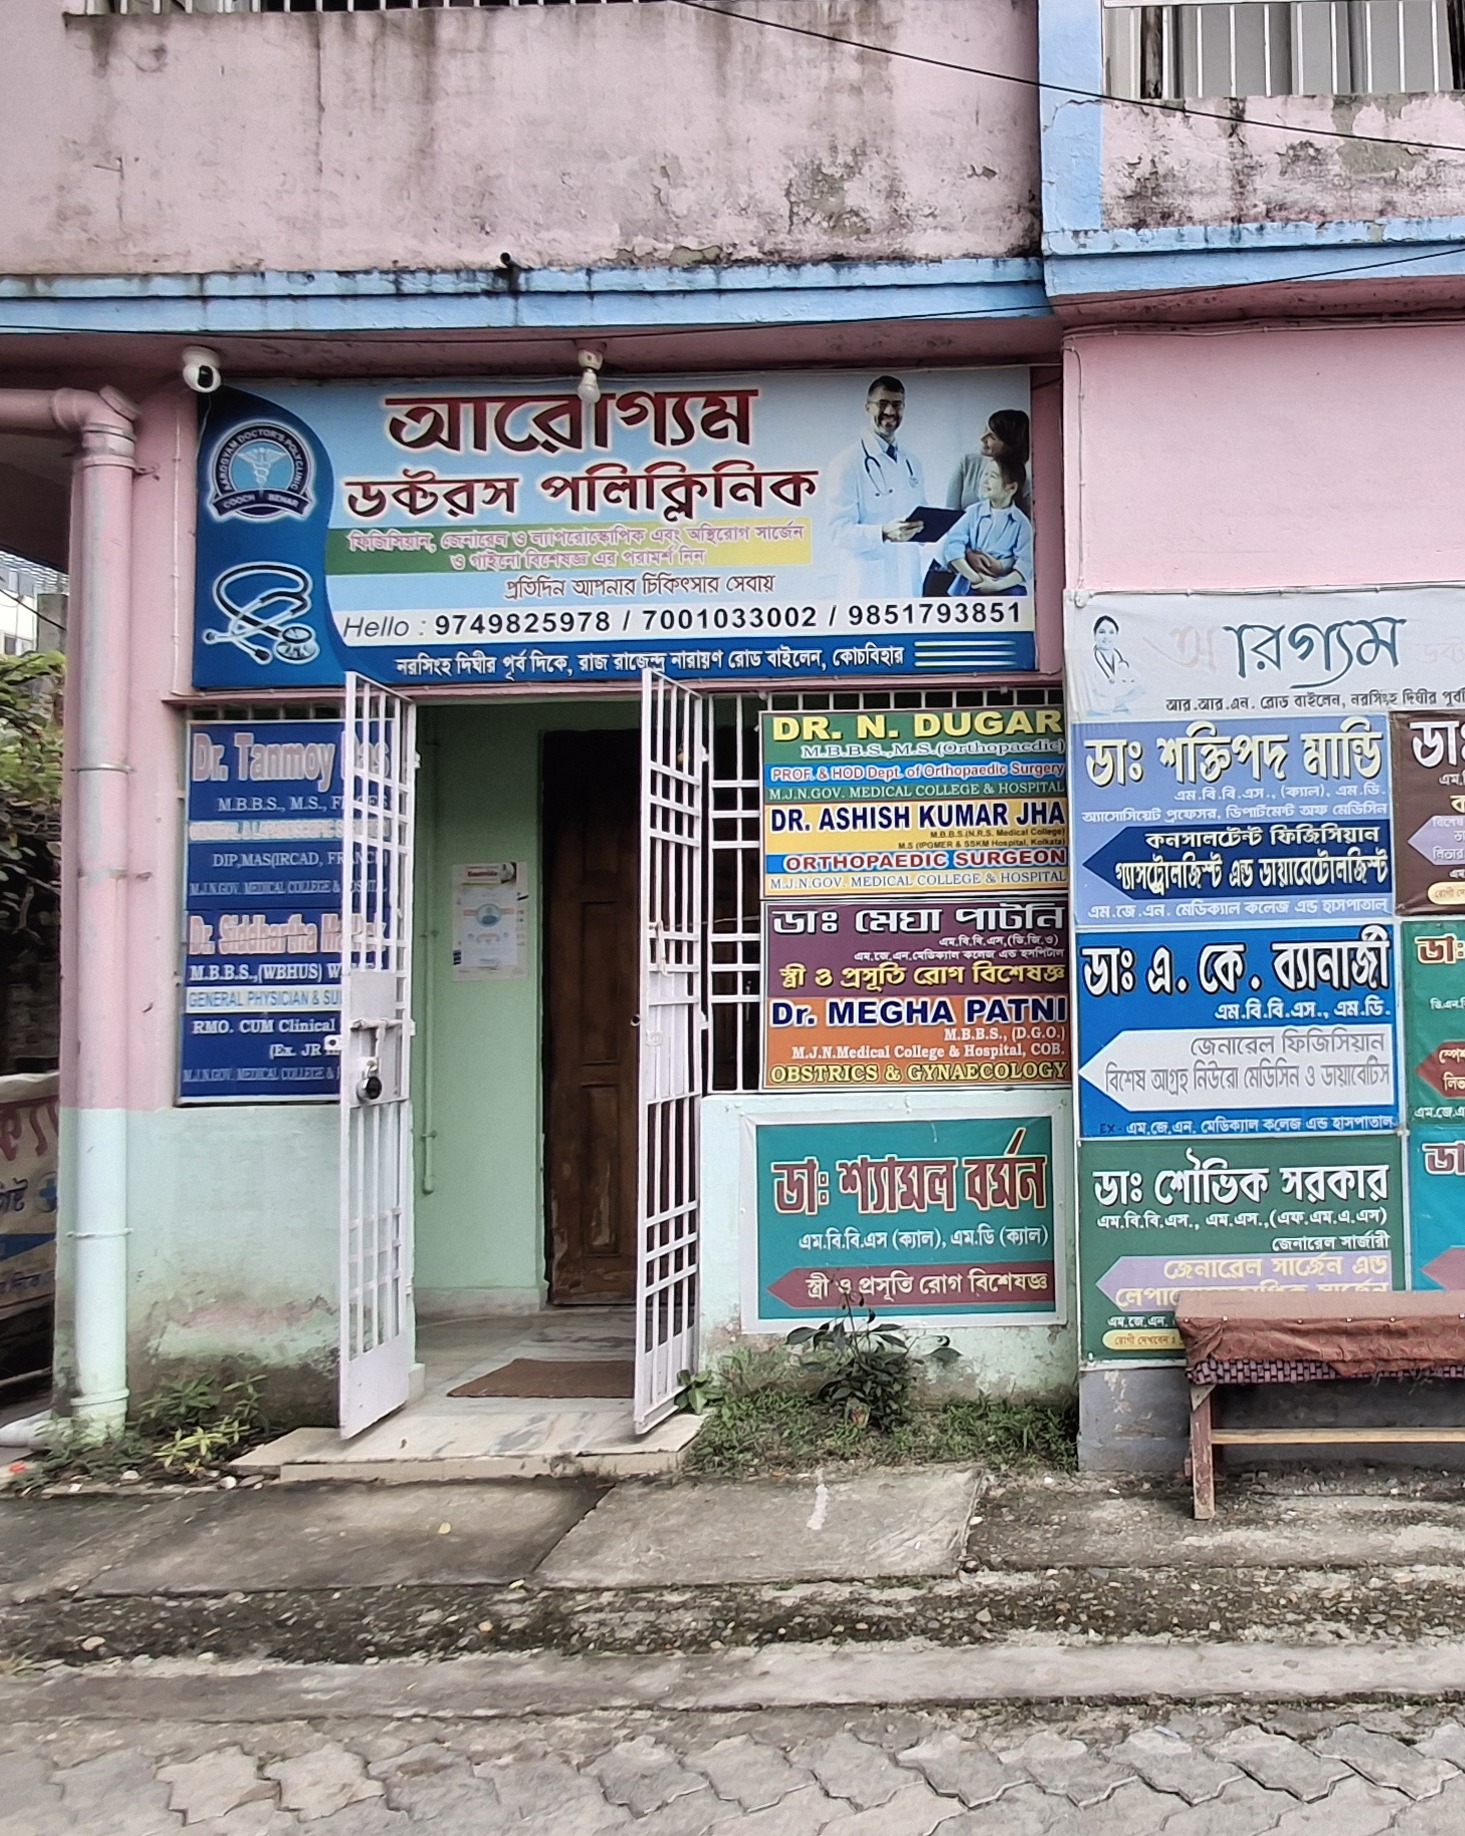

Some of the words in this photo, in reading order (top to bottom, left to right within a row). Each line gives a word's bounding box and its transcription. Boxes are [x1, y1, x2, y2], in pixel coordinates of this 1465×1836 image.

[384, 388, 760, 453] আরোগ্যম
[344, 468, 519, 517] ডক্টরস
[541, 459, 818, 520] পলিক্লিনিক
[572, 578, 635, 596] আপনার
[343, 616, 410, 638] Hello
[435, 611, 610, 636] 9749825978
[642, 606, 818, 631] 7001033002
[849, 602, 1019, 626] 9851793851
[728, 652, 761, 668] রোড
[773, 717, 842, 741] DR.
[857, 715, 898, 738] N.
[914, 710, 1062, 737] DUGAR
[193, 733, 228, 781] Dr.
[235, 732, 335, 792] Tanmoy
[1084, 739, 1143, 786] ডাঃ
[1157, 720, 1288, 784] শক্তিপদ
[831, 768, 864, 779] HOD
[924, 763, 1008, 778] Orthopaedic
[1012, 762, 1065, 778] Surgery
[850, 786, 913, 798] MEDICAL
[917, 785, 979, 797] COLLEGE
[999, 781, 1065, 794] HOSPITAL
[771, 808, 810, 831] DR.
[819, 806, 910, 830] ASHISH
[919, 803, 1008, 828] KUMAR
[1017, 801, 1065, 825] JHA
[785, 853, 948, 871] ORTHOPAEDIC
[955, 850, 1065, 866] SURGEON
[851, 875, 913, 887] MEDICAL
[918, 873, 980, 885] COLLEGE
[1001, 871, 1066, 883] HOSPITAL
[772, 910, 838, 934] ডাঃ
[855, 908, 943, 932] মেঘা
[955, 903, 1065, 931] পাটনি
[913, 966, 965, 986] রোগ
[972, 961, 1066, 985] বিশেষজ্ঞ
[1082, 947, 1135, 996] ডাঃ
[189, 992, 242, 1007] GENERAL
[248, 991, 308, 1006] PHYSICIAN
[772, 1002, 815, 1025] Dr.
[828, 1000, 953, 1024] MEGHA
[967, 998, 1067, 1022] PATNI
[239, 1019, 274, 1033] CUM
[279, 1018, 335, 1032] Clinical
[894, 1046, 944, 1060] College
[964, 1043, 1026, 1058] Hospital,
[1190, 1036, 1275, 1056] জেনারেল
[771, 1065, 879, 1083] OBSTRICS
[907, 1062, 1067, 1082] GYNAECOLOGY
[1105, 1061, 1146, 1093] বিশেষ
[1244, 1058, 1300, 1089] মেডিসিন
[836, 1154, 958, 1214] শ্যামল
[962, 1128, 1047, 1210] বর্মন
[1093, 1171, 1143, 1206] ডাঃ
[1154, 1147, 1269, 1205] শৌভিক
[1280, 1165, 1389, 1203] সরকার
[920, 1275, 963, 1294] রোগ
[968, 1267, 1048, 1293] বিশেষজ্ঞ
